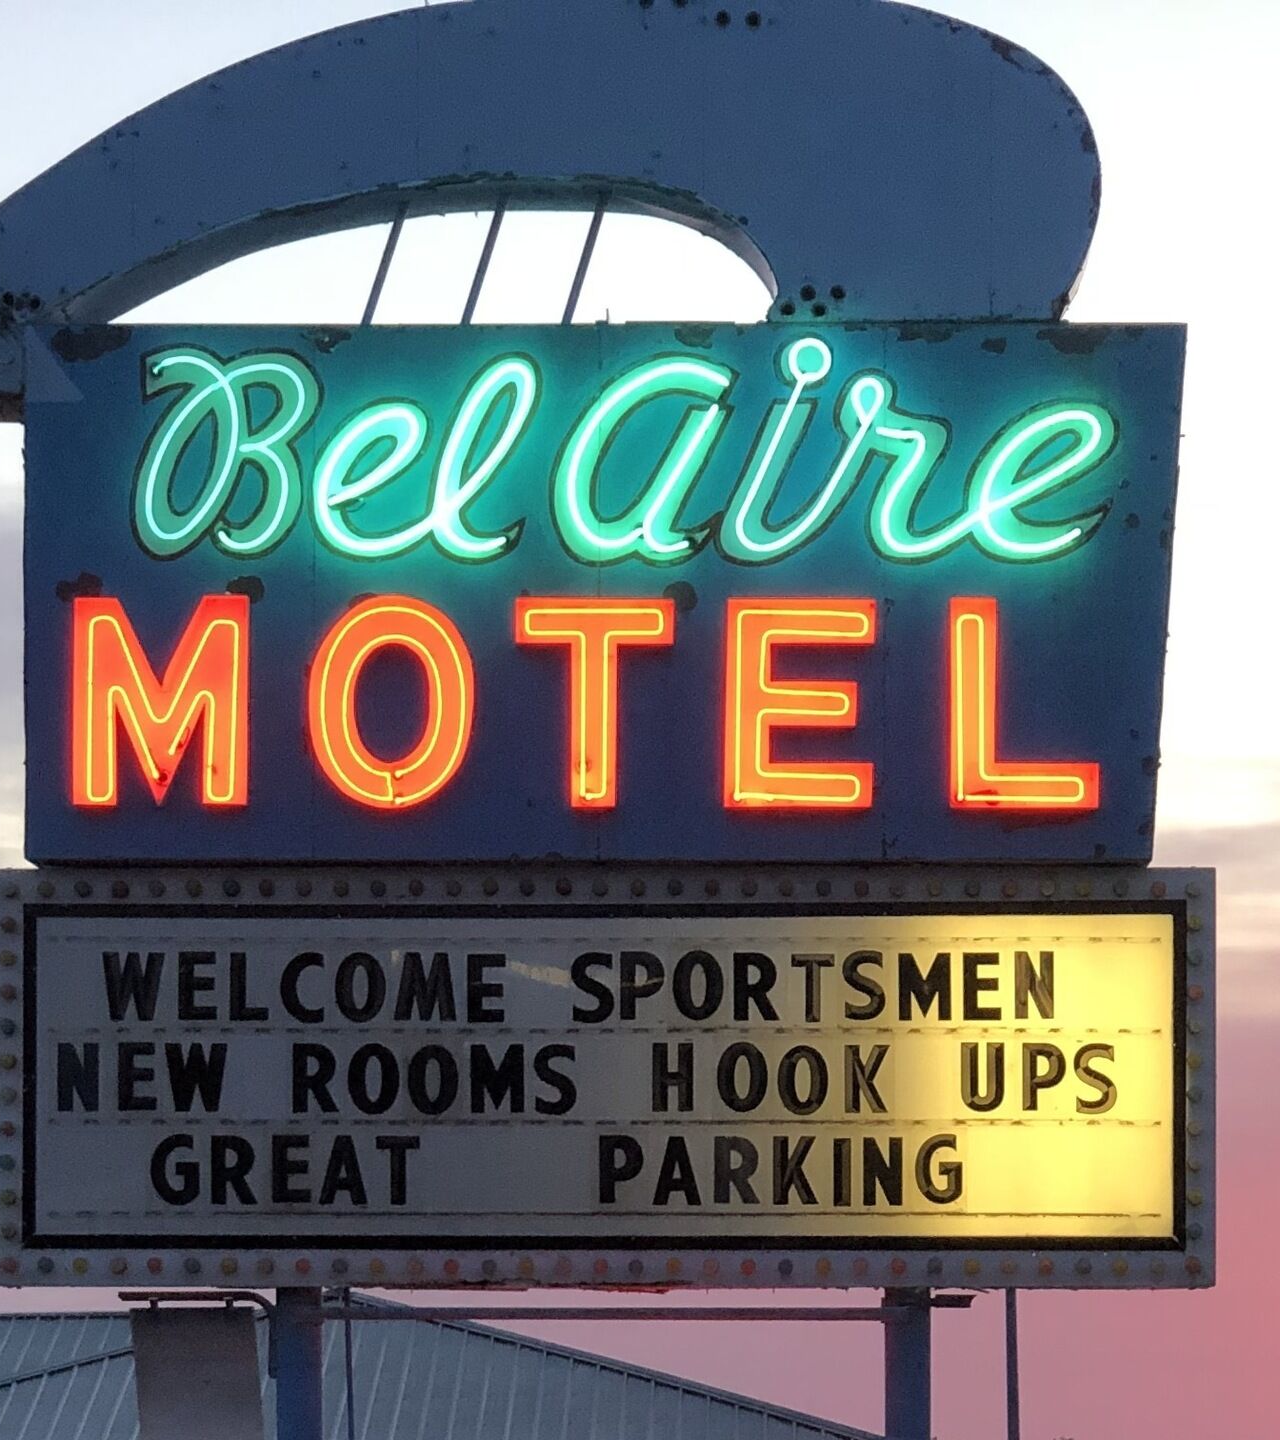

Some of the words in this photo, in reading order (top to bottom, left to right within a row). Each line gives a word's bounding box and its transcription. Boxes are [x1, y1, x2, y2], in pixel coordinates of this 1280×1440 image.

[132, 346, 538, 563] Bel
[554, 336, 1117, 563] Aire
[71, 594, 1101, 811] MOTEL
[103, 949, 507, 1026] WELCOME
[571, 948, 1058, 1026] SPORTSMEN
[56, 1041, 228, 1115] NEW
[291, 1041, 578, 1117] ROOMS
[651, 1041, 889, 1117] HOOK
[960, 1041, 1119, 1115] UPS
[149, 1133, 421, 1207] GREAT
[598, 1133, 966, 1207] PARKING
